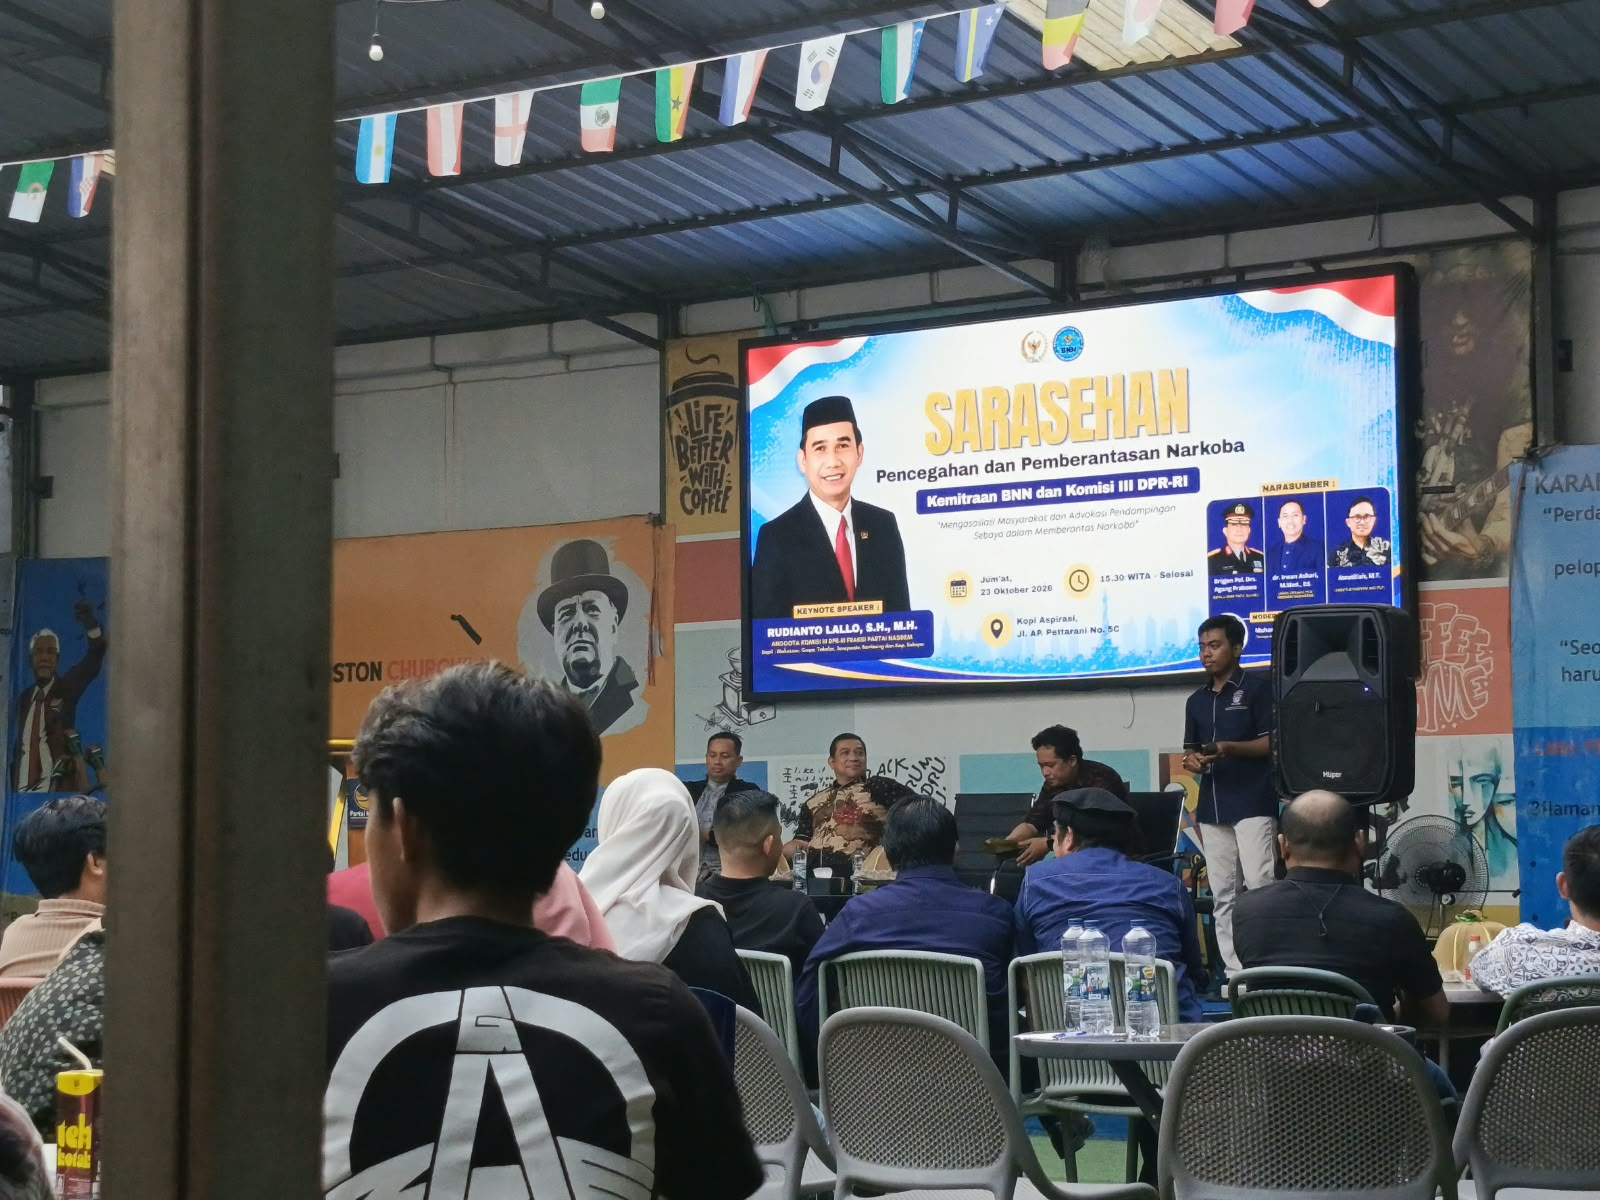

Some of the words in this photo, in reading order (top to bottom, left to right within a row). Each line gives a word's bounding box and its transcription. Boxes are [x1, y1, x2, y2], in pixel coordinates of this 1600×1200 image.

[924, 368, 1191, 456] SARASEHAN
[876, 463, 980, 483] Pencegahan
[984, 459, 1016, 474] dan
[1021, 446, 1160, 471] Pemberantasan
[1166, 439, 1245, 458] Narkoba
[927, 491, 998, 508] Kemitraan
[1001, 488, 1033, 502] BNN
[1036, 486, 1062, 499] dan
[1066, 480, 1115, 497] Komisi
[1118, 478, 1134, 493] III
[1137, 475, 1189, 491] DPR-RI
[1262, 480, 1329, 493] NARASUMBER
[1127, 572, 1151, 581] WITA
[1159, 569, 1194, 579] Selesai
[993, 586, 1029, 595] Oktober
[797, 606, 835, 615] KEYNOTE
[837, 603, 875, 612] SPEAKER
[1016, 617, 1037, 626] Kopi
[1039, 614, 1078, 625] Aspirasi,
[767, 625, 823, 638] RUDIANTO
[825, 623, 863, 635] LALLO,
[865, 621, 891, 633] S.H.,
[893, 620, 918, 631] M.H.
[1046, 627, 1087, 636] Pettarani
[1090, 626, 1105, 634] No.
[57, 1112, 93, 1150] teh
